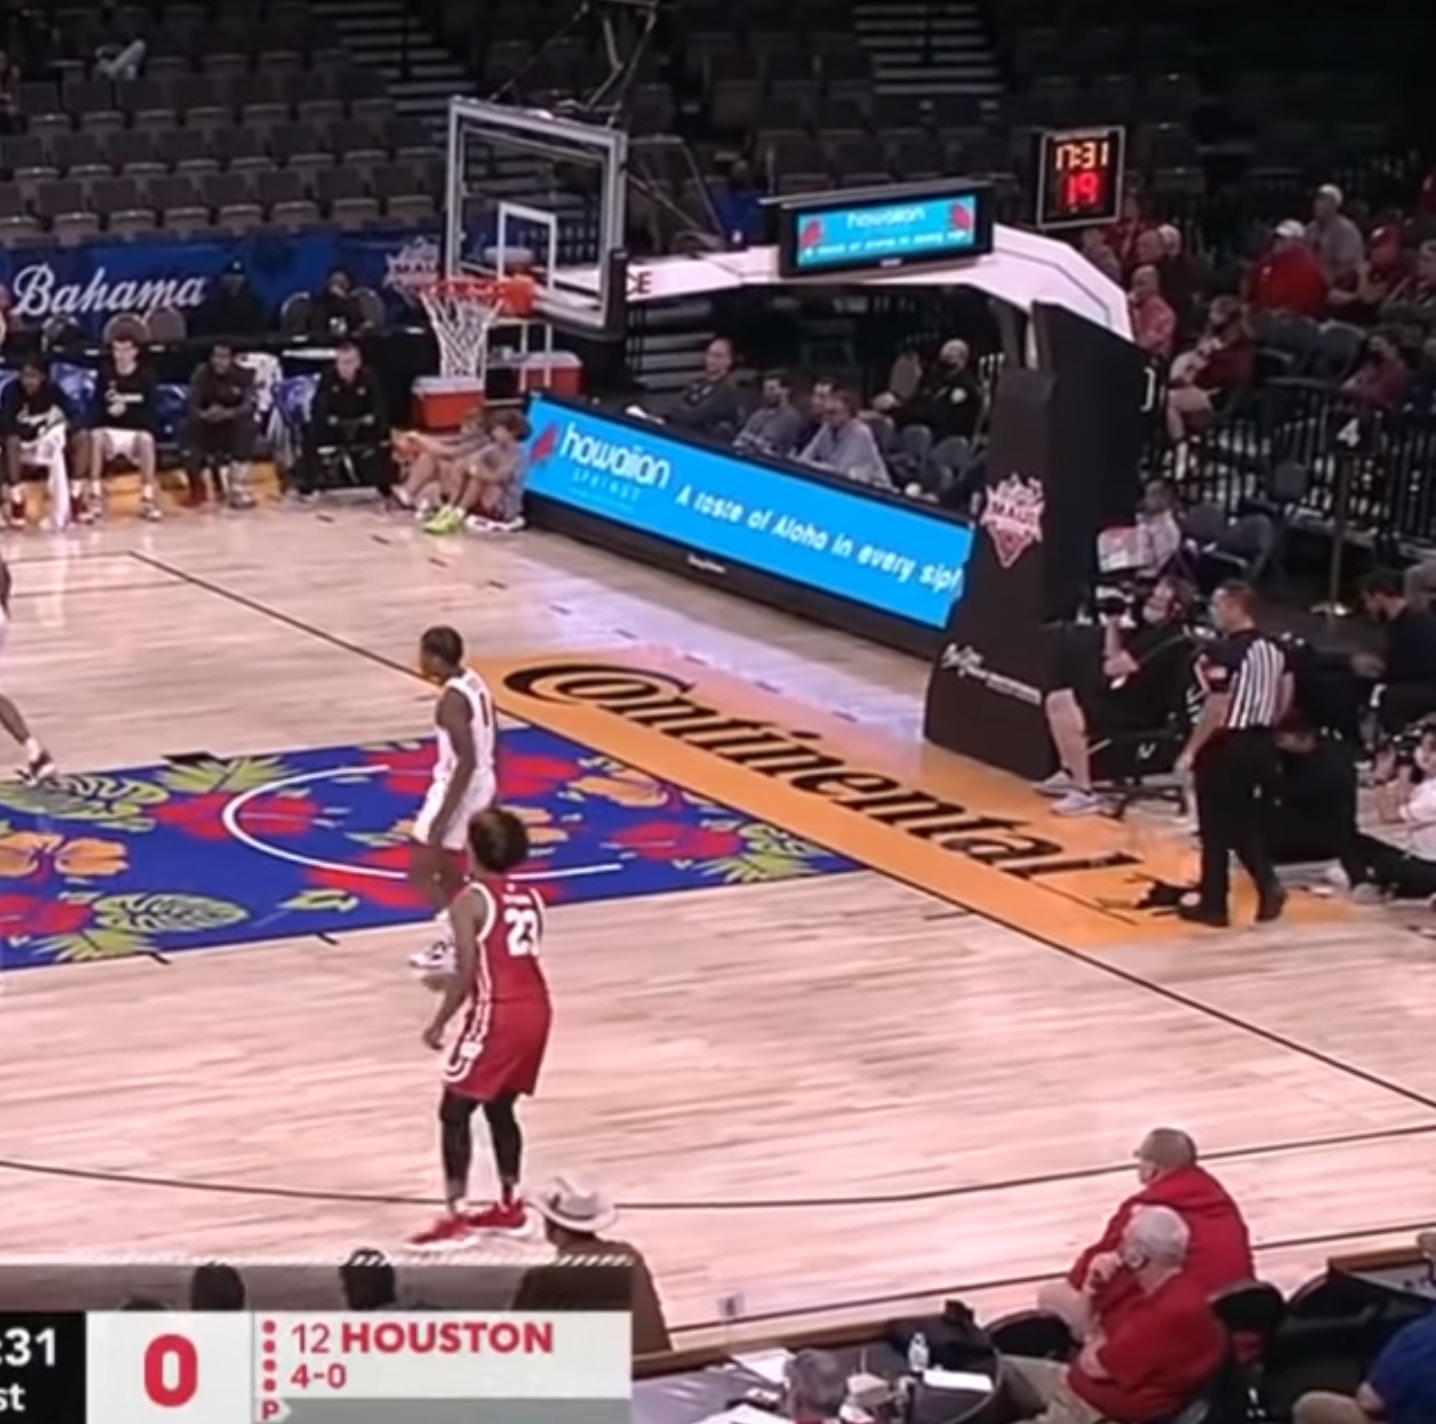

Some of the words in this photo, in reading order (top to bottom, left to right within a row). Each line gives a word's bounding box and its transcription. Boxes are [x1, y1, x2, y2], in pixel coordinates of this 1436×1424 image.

[12, 262, 207, 316] Bahama
[559, 421, 671, 489] hawaiian
[674, 484, 692, 506] A
[771, 514, 828, 551] Aloha
[832, 533, 853, 558] in
[856, 545, 914, 584] every
[503, 664, 1146, 878] Continental
[504, 907, 540, 957] 23
